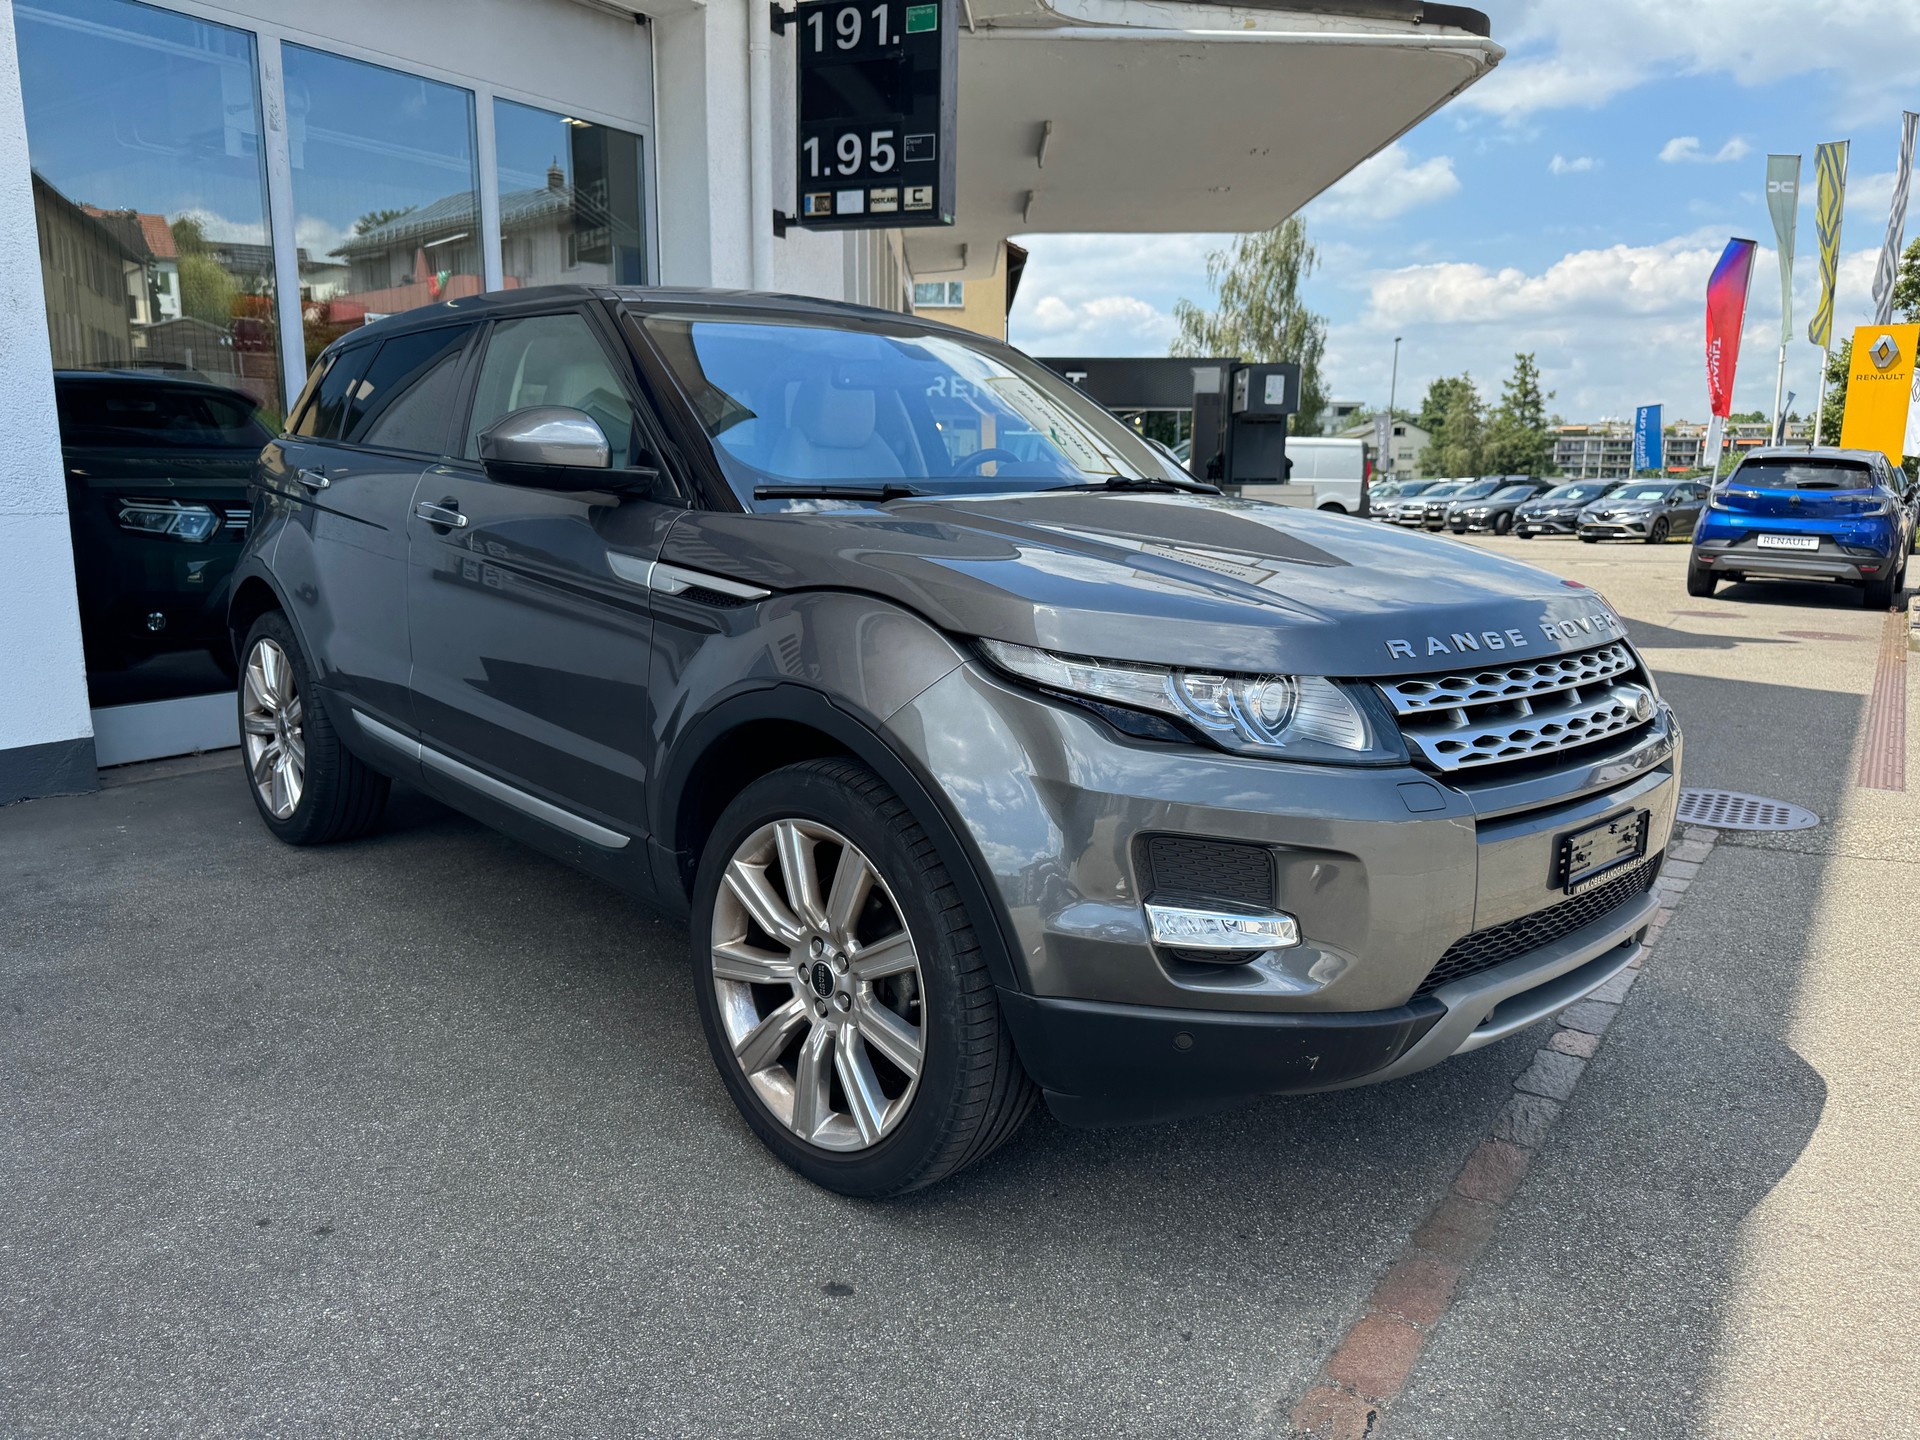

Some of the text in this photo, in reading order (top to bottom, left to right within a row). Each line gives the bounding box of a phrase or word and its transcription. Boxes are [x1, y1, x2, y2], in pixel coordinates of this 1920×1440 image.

[803, 130, 896, 177] 1.95
[870, 197, 897, 205] POSTCARD
[1855, 373, 1905, 381] RENAULT
[1763, 536, 1814, 547] RENAULT
[1384, 612, 1618, 660] RANGE ROVER
